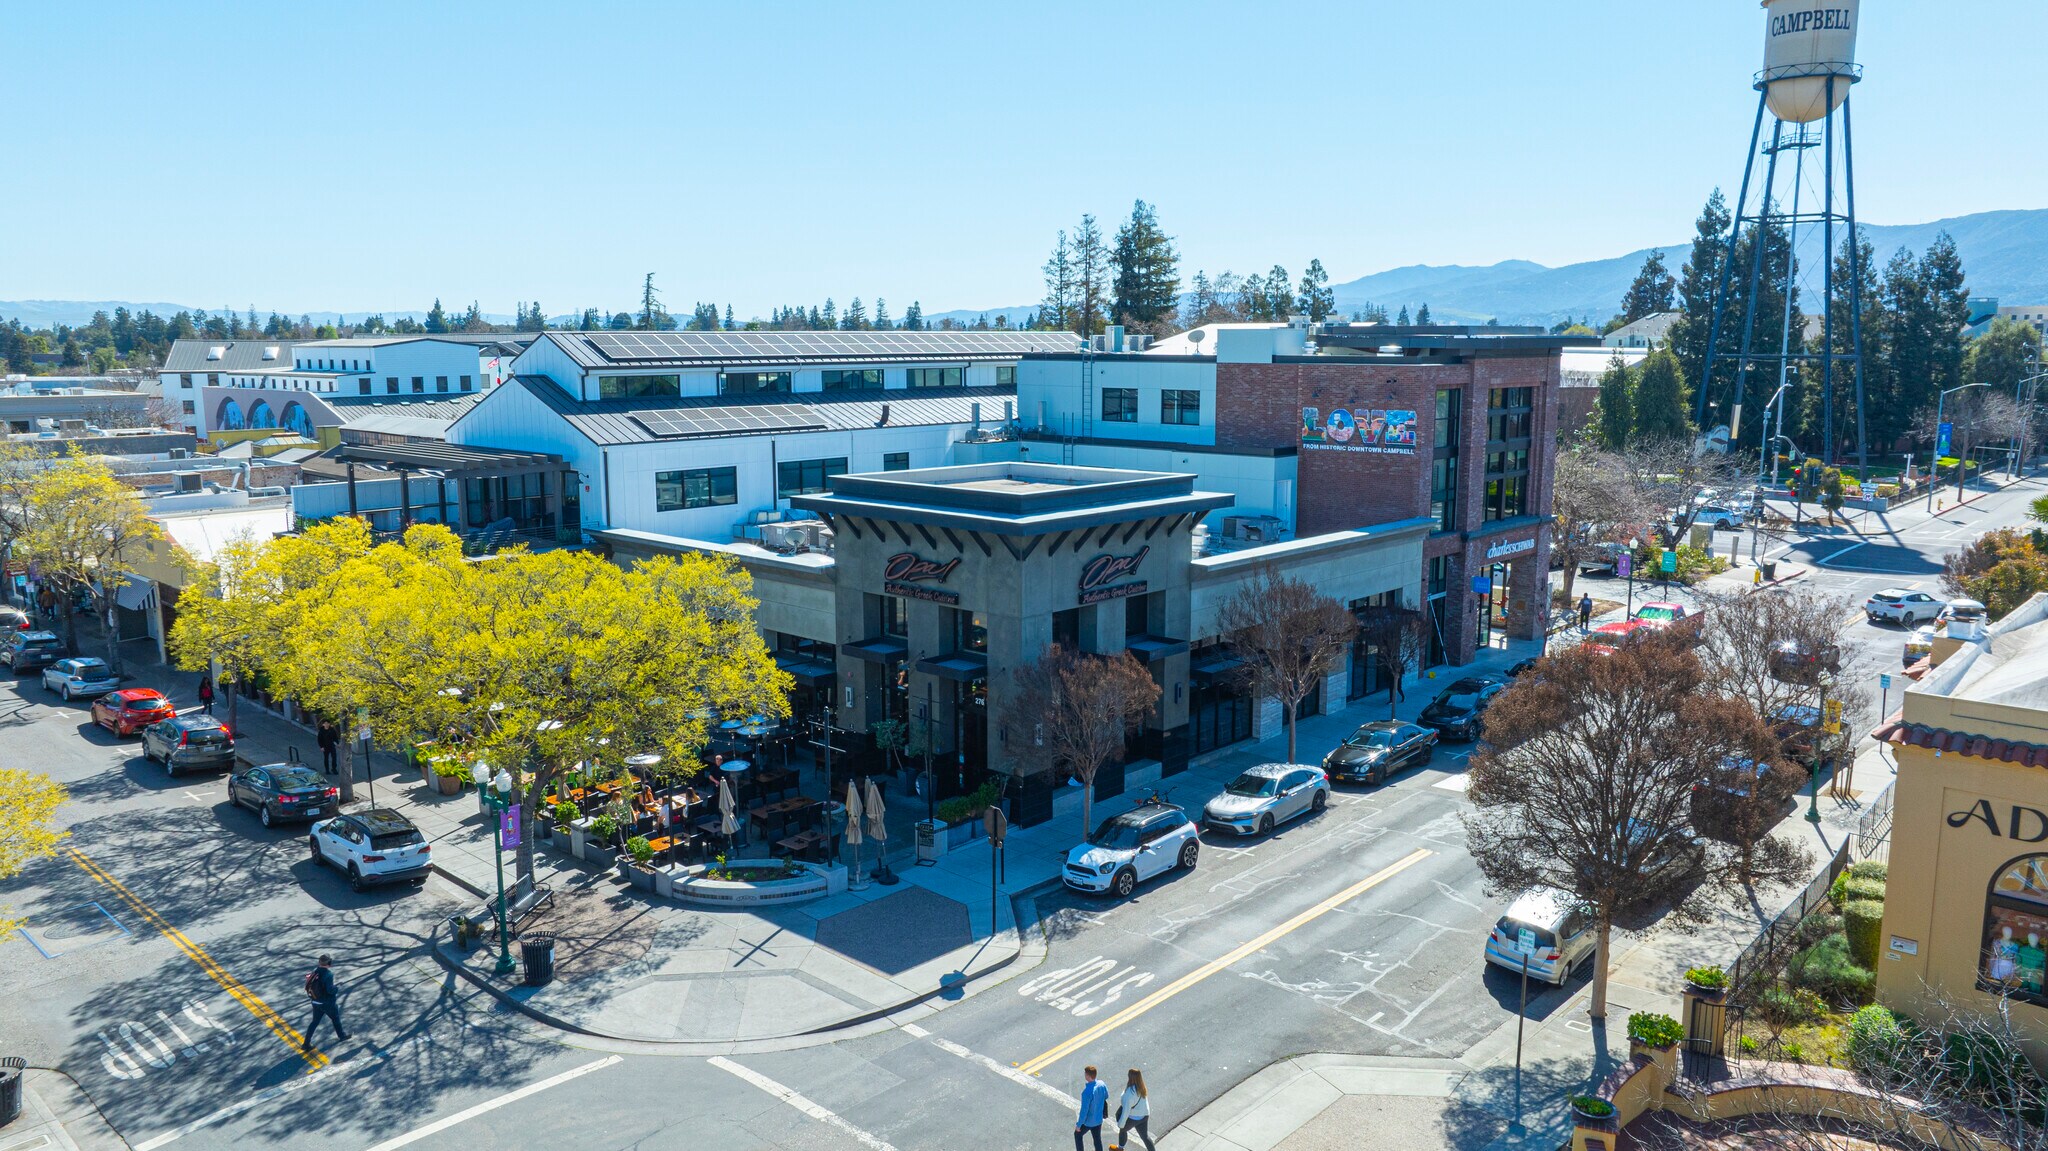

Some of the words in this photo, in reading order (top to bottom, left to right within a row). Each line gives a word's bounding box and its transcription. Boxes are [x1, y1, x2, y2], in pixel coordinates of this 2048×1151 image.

[1772, 9, 1850, 37] CAMPBELL
[1302, 407, 1417, 446] LOVE
[886, 584, 914, 597] Authentic
[914, 589, 933, 600] Greek
[933, 592, 956, 604] Cuisine
[1083, 590, 1110, 604] Authentic
[1111, 587, 1127, 598] Greek
[1127, 583, 1147, 594] Cuisine
[1947, 799, 2048, 842] AD
[1018, 955, 1155, 1017] STOP
[98, 1000, 236, 1080] STOP
